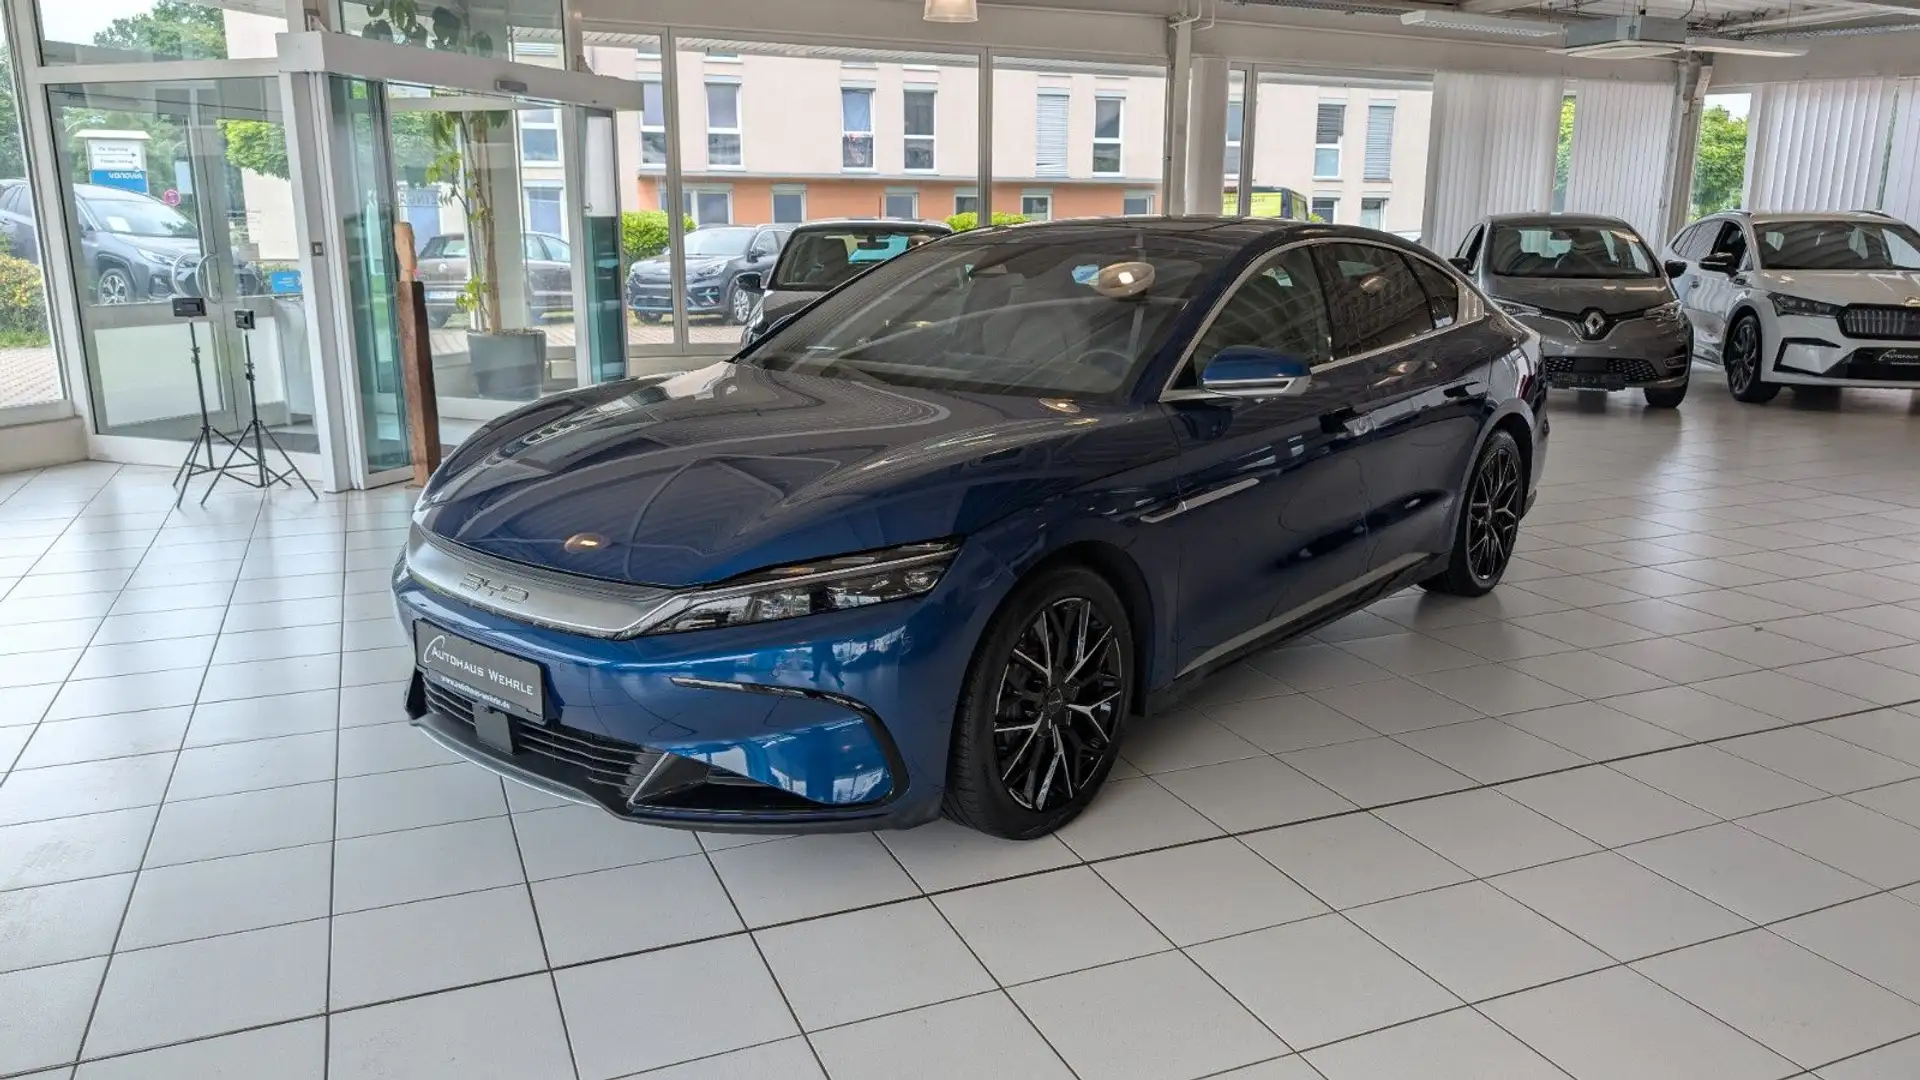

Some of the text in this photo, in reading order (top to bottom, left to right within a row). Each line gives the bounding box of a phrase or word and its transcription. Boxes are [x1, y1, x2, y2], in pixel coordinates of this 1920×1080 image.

[460, 572, 529, 604] BYD
[430, 645, 533, 696] AUTOHAUS WEHRLE
